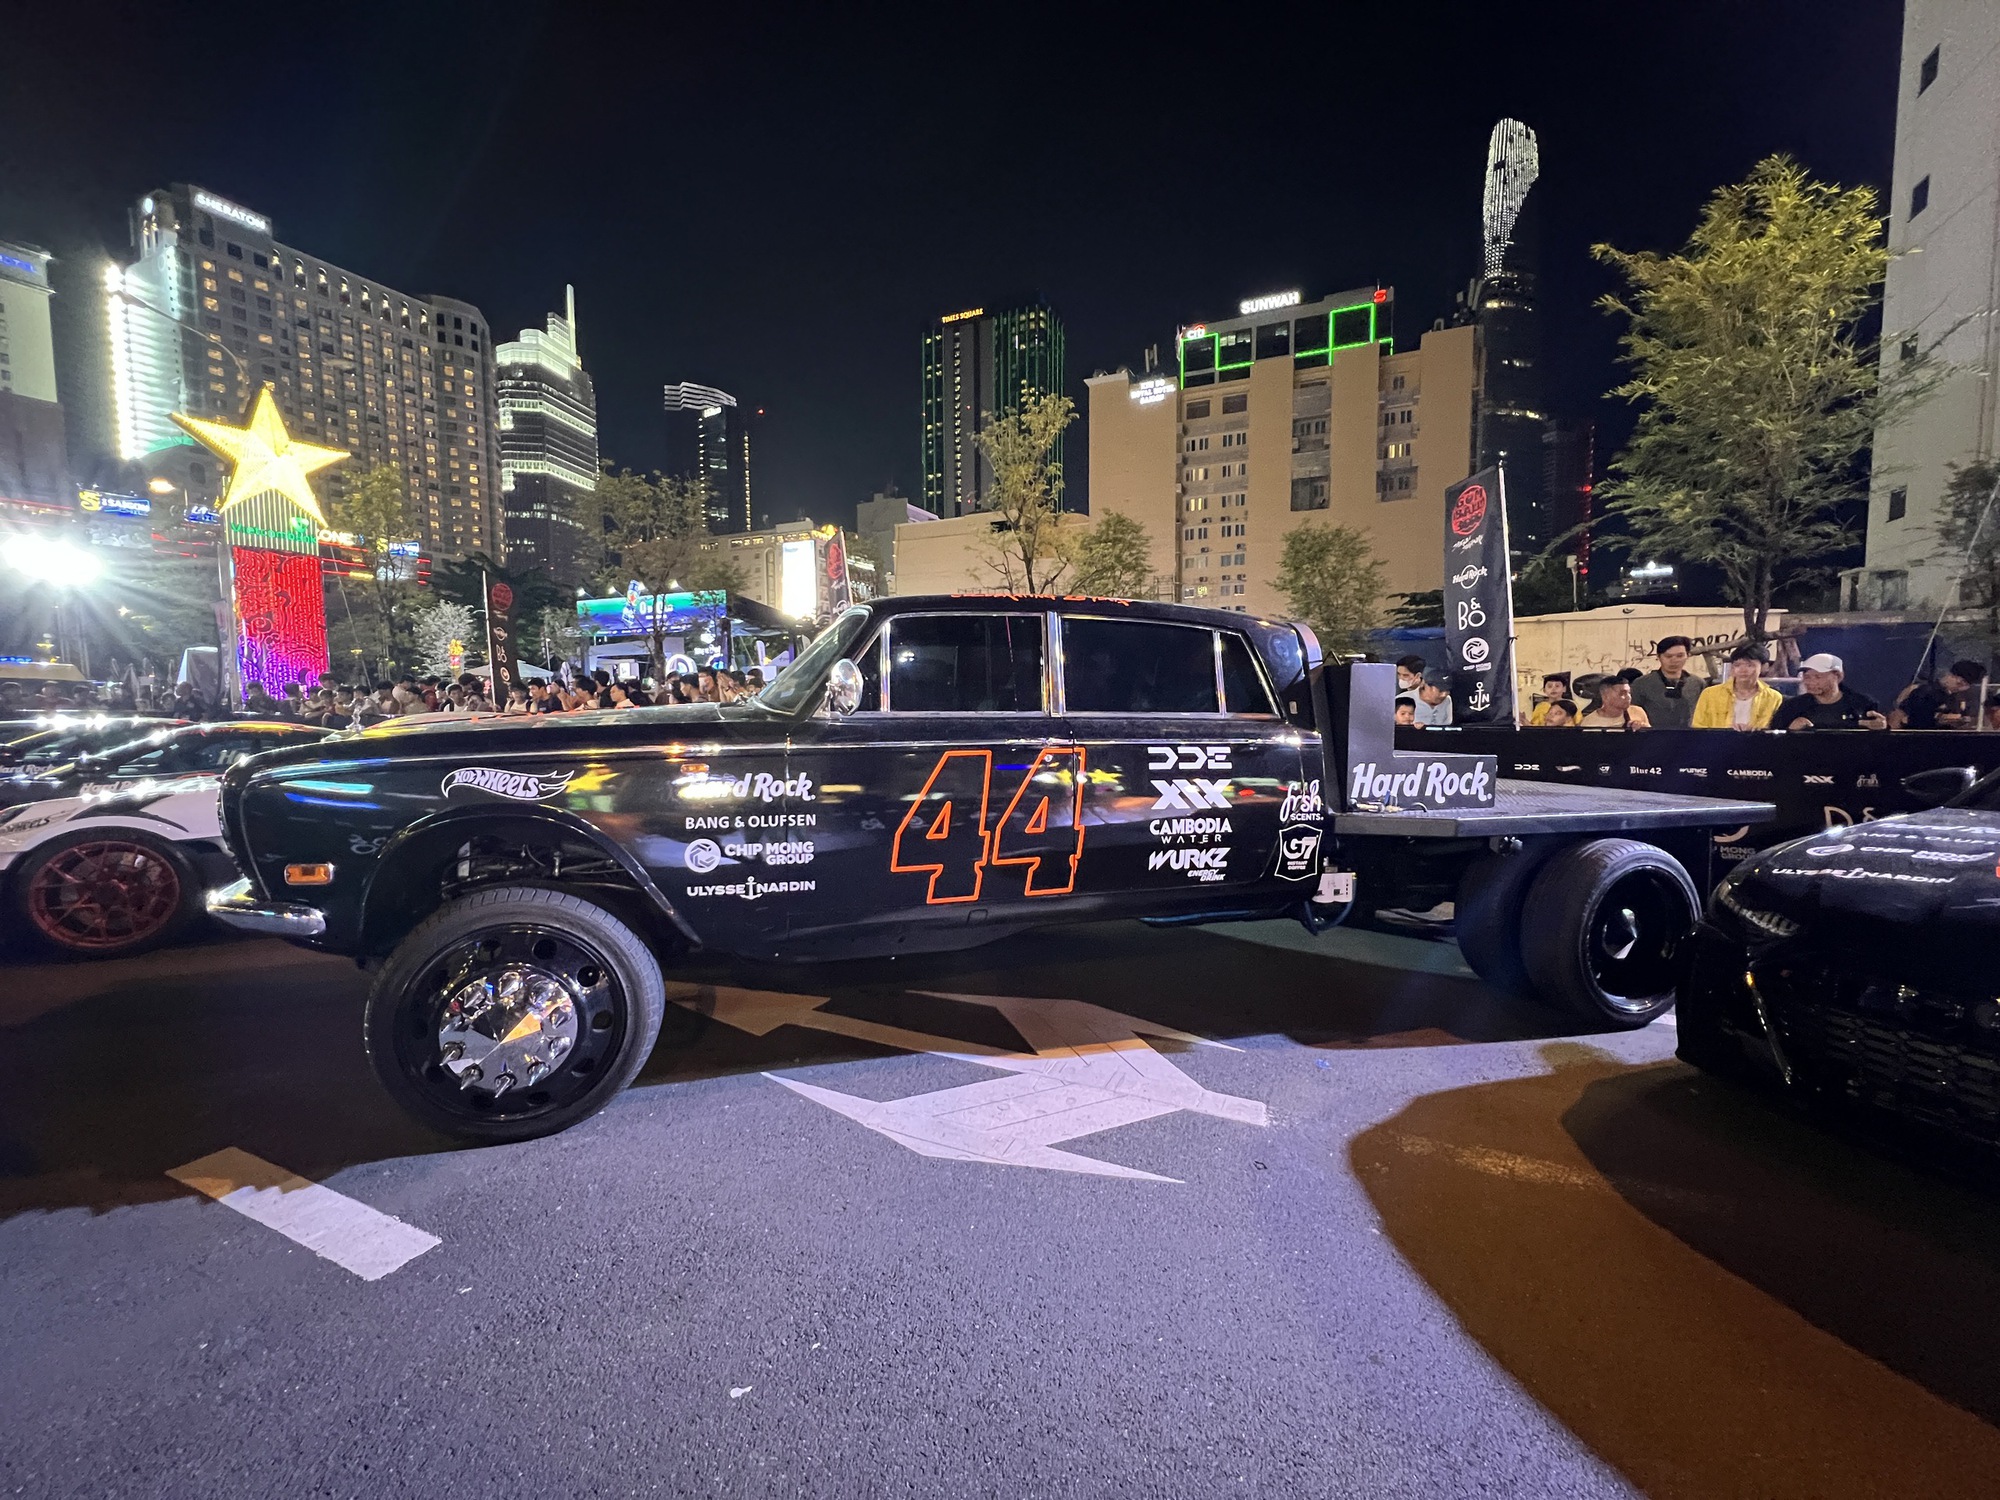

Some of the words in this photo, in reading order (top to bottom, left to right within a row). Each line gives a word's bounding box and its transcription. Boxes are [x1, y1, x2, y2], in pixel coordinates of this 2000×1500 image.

[196, 194, 266, 229] SHERATON
[0, 254, 36, 273] OTEL
[1240, 291, 1300, 314] SUNWAH
[942, 313, 960, 323] TIMES
[960, 308, 983, 320] SQUARE
[230, 522, 317, 544] Vietcombank
[1452, 571, 1470, 584] Hard
[1469, 566, 1488, 580] Rock
[1629, 766, 1648, 775] Blue
[1649, 766, 1662, 775] 42
[1727, 769, 1774, 777] CAMBODIA
[1350, 762, 1425, 798] Hard
[685, 816, 729, 829] BANG
[734, 816, 745, 828] &
[748, 814, 816, 828] OLUFSEN
[890, 748, 1086, 904] 44
[1149, 818, 1233, 835] CAMBODIA
[1161, 834, 1222, 844] WATER
[1283, 835, 1318, 860] G7
[724, 843, 763, 856] CHIP
[766, 841, 814, 854] MONG
[766, 854, 814, 865] GROUP
[1148, 847, 1231, 870] WURKZ
[1772, 868, 1846, 877] ULYSSE
[1861, 870, 1955, 883] NARDIN
[687, 884, 745, 896] ULYSSE
[757, 880, 816, 893] NARDIN
